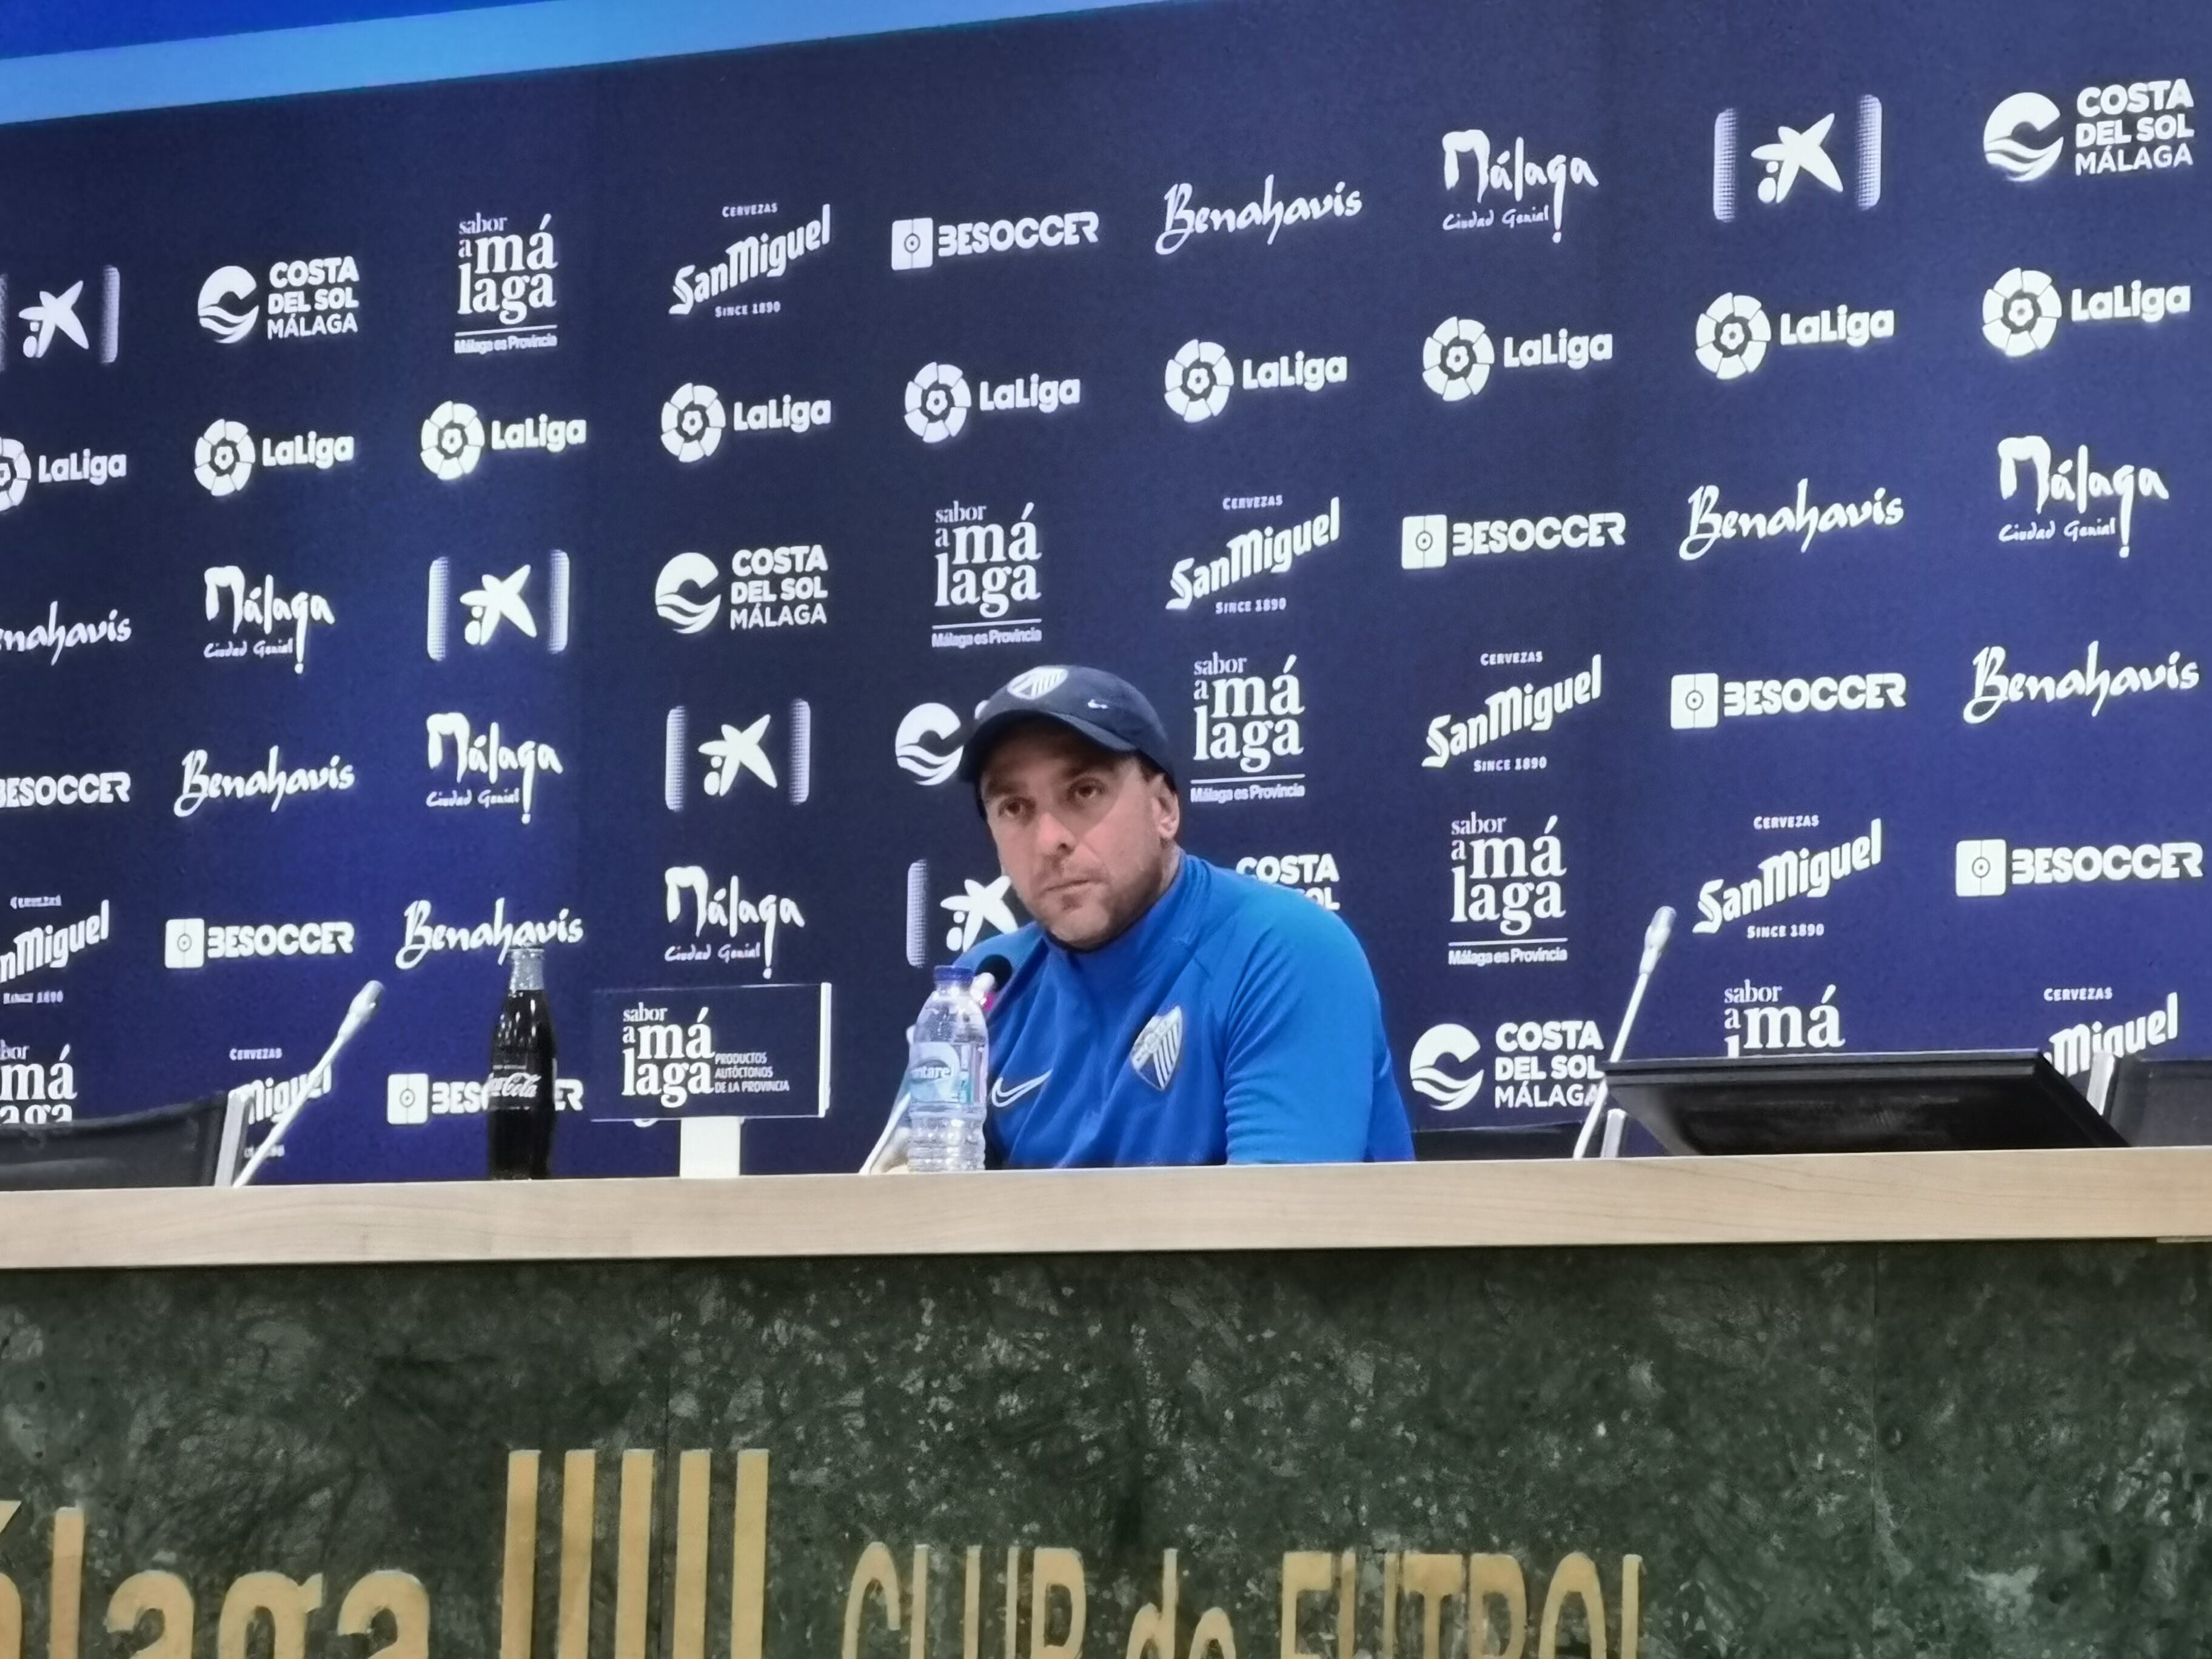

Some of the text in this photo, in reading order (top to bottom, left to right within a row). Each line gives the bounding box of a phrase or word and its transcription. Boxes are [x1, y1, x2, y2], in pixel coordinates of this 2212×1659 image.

[2077, 79, 2194, 118] COSTA
[2076, 113, 2194, 146] DEL SOL
[2075, 143, 2194, 176] MÁLAGA
[1443, 130, 1598, 243] Málaga
[459, 212, 507, 234] sabor
[938, 212, 1099, 256] BESOCCER
[1443, 210, 1494, 230] Ciudad
[458, 213, 558, 274] a má
[270, 256, 359, 288] COSTA
[268, 287, 359, 314] DEL SOL
[458, 263, 556, 324] laga
[2071, 280, 2190, 323] LaLiga
[267, 310, 358, 339] MÁLAGA
[1780, 304, 1894, 347] LaLiga
[1504, 329, 1612, 369] LaLiga
[1243, 350, 1347, 391] LaLiga
[980, 374, 1080, 413] LaLiga
[734, 395, 831, 432] LaLiga
[263, 431, 354, 469] LaLiga
[492, 414, 586, 452] LaLiga
[39, 449, 126, 485] LaLiga
[936, 501, 987, 523] sabor
[1997, 435, 2169, 558] Málaga
[935, 501, 1042, 565] a má
[1453, 512, 1626, 556] BESOCCER
[1999, 520, 2055, 542] Ciudad
[732, 545, 828, 577] COSTA
[731, 576, 828, 605] DEL SOL
[935, 553, 1041, 618] laga
[0, 601, 131, 665] nahavís
[204, 566, 335, 674] Málaga
[731, 603, 826, 630] MÁLAGA
[204, 641, 247, 658] Ciudad
[1194, 652, 1247, 675] sabor
[1194, 654, 1305, 718] a má
[1724, 673, 1906, 716] BESOCCER
[1193, 705, 1304, 773] laga
[426, 712, 563, 823] Málaga
[426, 789, 472, 806] Ciudad
[1452, 811, 1506, 834] sabor
[1451, 815, 1567, 879] a má
[2012, 842, 2203, 884] BESOCCER
[1236, 854, 1340, 885] COSTA
[1304, 887, 1341, 910] OL
[1450, 866, 1566, 936] laga
[207, 922, 354, 958] BESOCCER
[665, 866, 805, 979] Málaga
[665, 945, 711, 961] Ciudad
[1724, 979, 1782, 1003] sabor
[623, 1002, 668, 1022] sabor
[1724, 1008, 1741, 1029] a
[1742, 984, 1845, 1048] má
[0, 1039, 29, 1060] bor
[623, 1007, 715, 1059] a má
[1496, 1021, 1604, 1052] COSTA
[715, 1053, 767, 1064] PRODUCTOS
[1495, 1054, 1604, 1081] DEL SOL
[432, 1079, 583, 1113] BESER
[622, 1048, 715, 1108] laga
[714, 1081, 789, 1093] DE LA PROVINCIA
